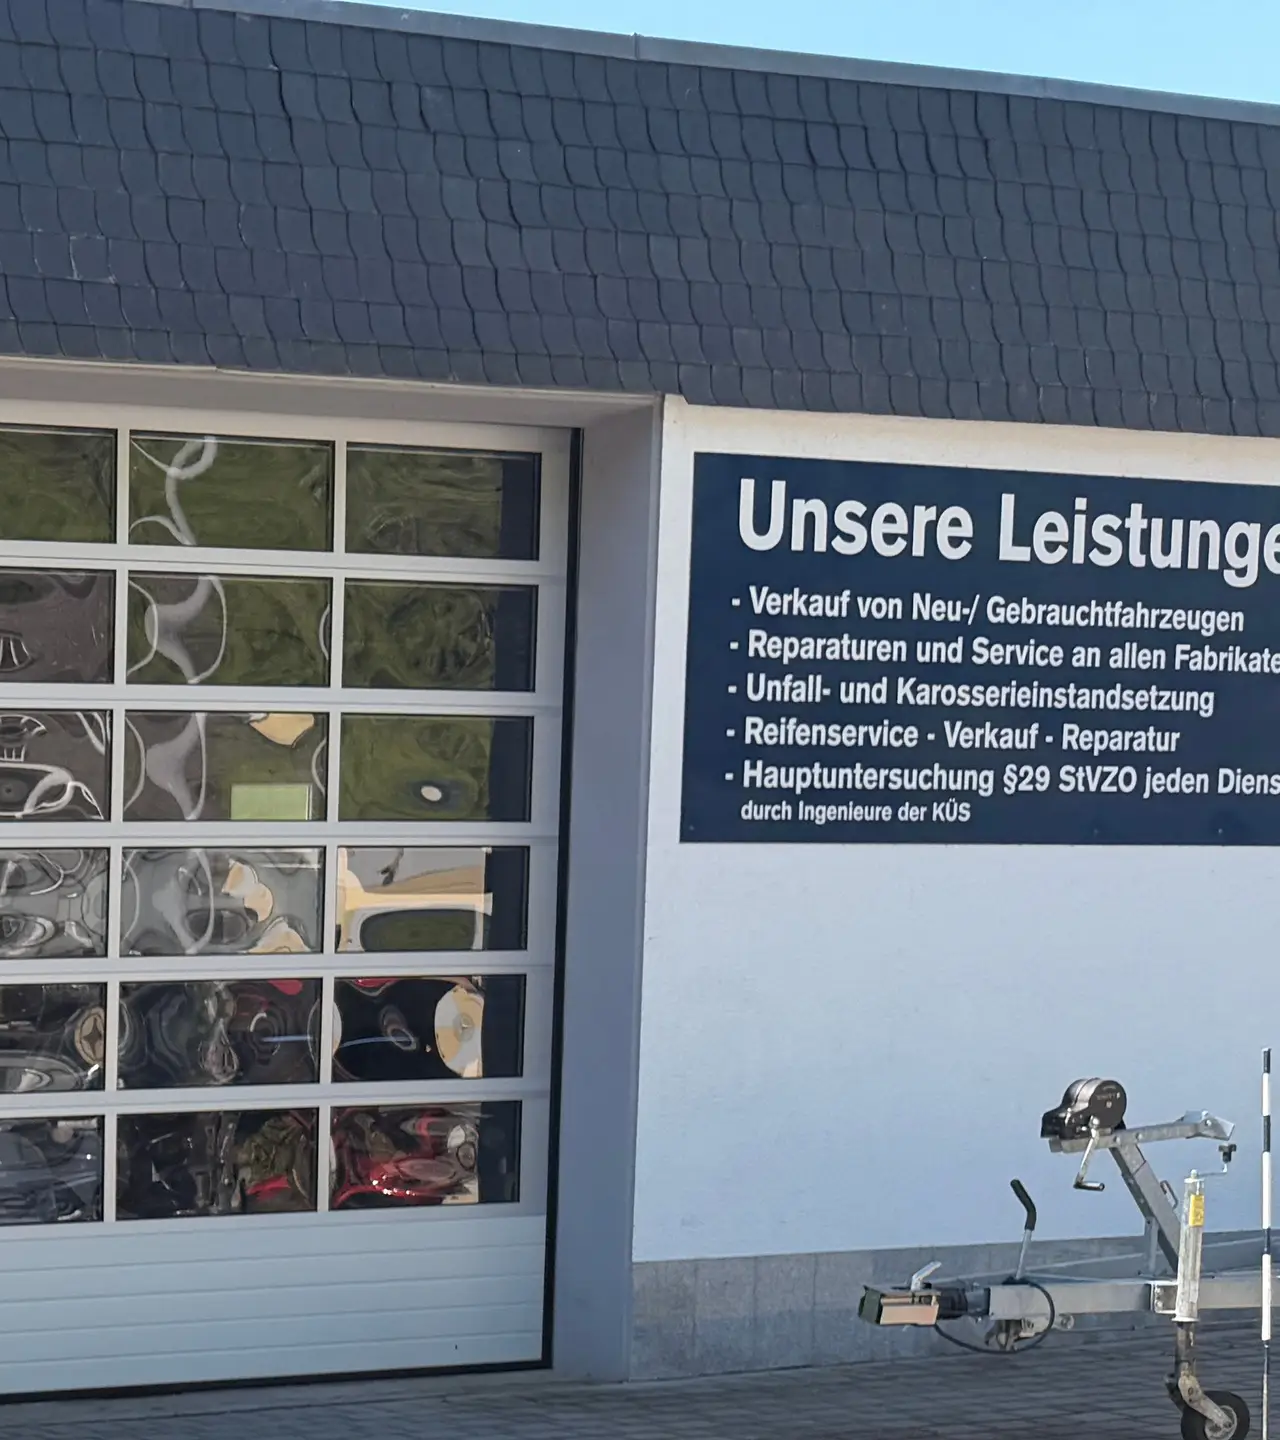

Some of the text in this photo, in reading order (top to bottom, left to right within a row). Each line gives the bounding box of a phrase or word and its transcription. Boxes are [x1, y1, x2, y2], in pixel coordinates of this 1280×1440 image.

[739, 478, 974, 560] Unsere
[749, 585, 851, 618] Verkauf
[856, 596, 903, 620] von
[912, 592, 980, 626] Neu-/
[986, 595, 1245, 637] Gebrauchtfahrzeugen
[748, 628, 907, 665] Reparaturen
[916, 636, 964, 664] und
[971, 636, 1064, 667] Service
[1071, 646, 1101, 668] an
[1109, 641, 1166, 670] allen
[746, 672, 831, 703] Unfall-
[839, 676, 888, 704] und
[896, 676, 1215, 718] Karosserieinstandsetzung
[744, 716, 919, 748] Reifenservice
[943, 720, 1040, 750] Verkauf
[1061, 723, 1181, 757] Reparatur
[743, 759, 995, 797] Hauptuntersuchung
[1003, 763, 1051, 795] §29
[1058, 764, 1138, 793] StVZO
[1142, 766, 1209, 799] jeden
[740, 797, 971, 825] durch Ingenieure der KÜS
